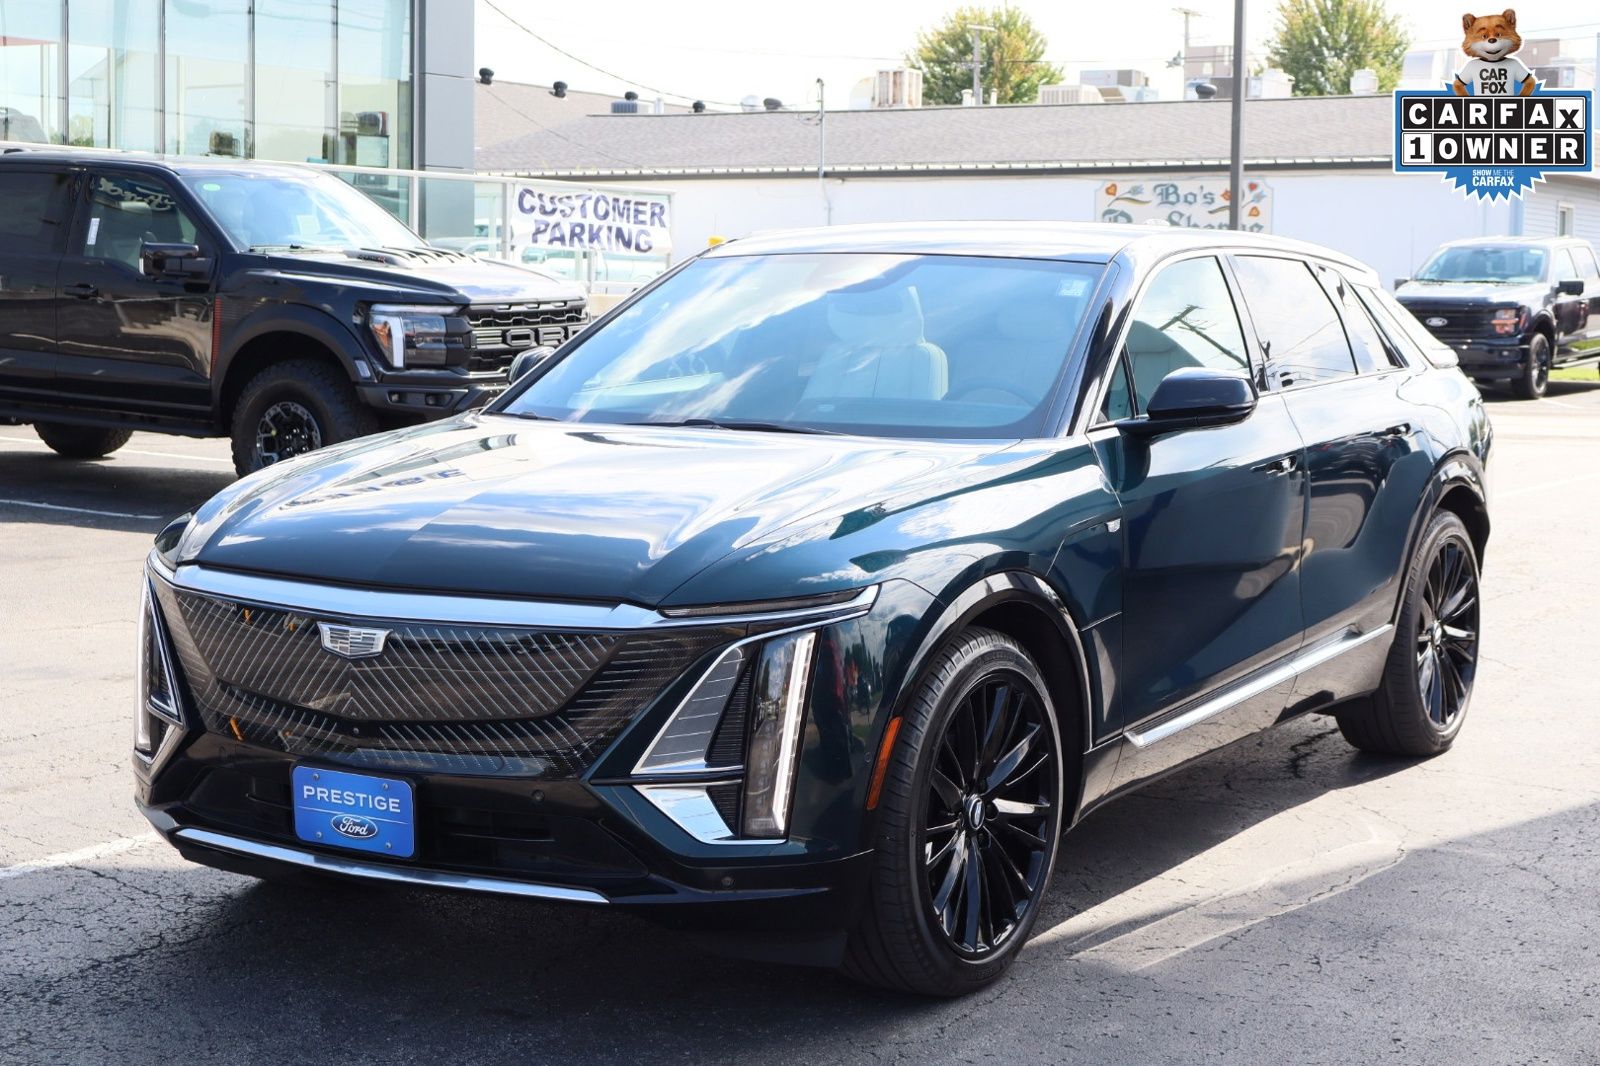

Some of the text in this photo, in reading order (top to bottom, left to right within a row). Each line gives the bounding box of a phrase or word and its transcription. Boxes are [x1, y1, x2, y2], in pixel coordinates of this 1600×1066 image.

[517, 187, 667, 229] CUSTOMER
[1153, 183, 1216, 208] Bo's
[531, 219, 654, 254] PARKING
[303, 785, 401, 813] PRESTIGE
[339, 816, 369, 836] Ford
